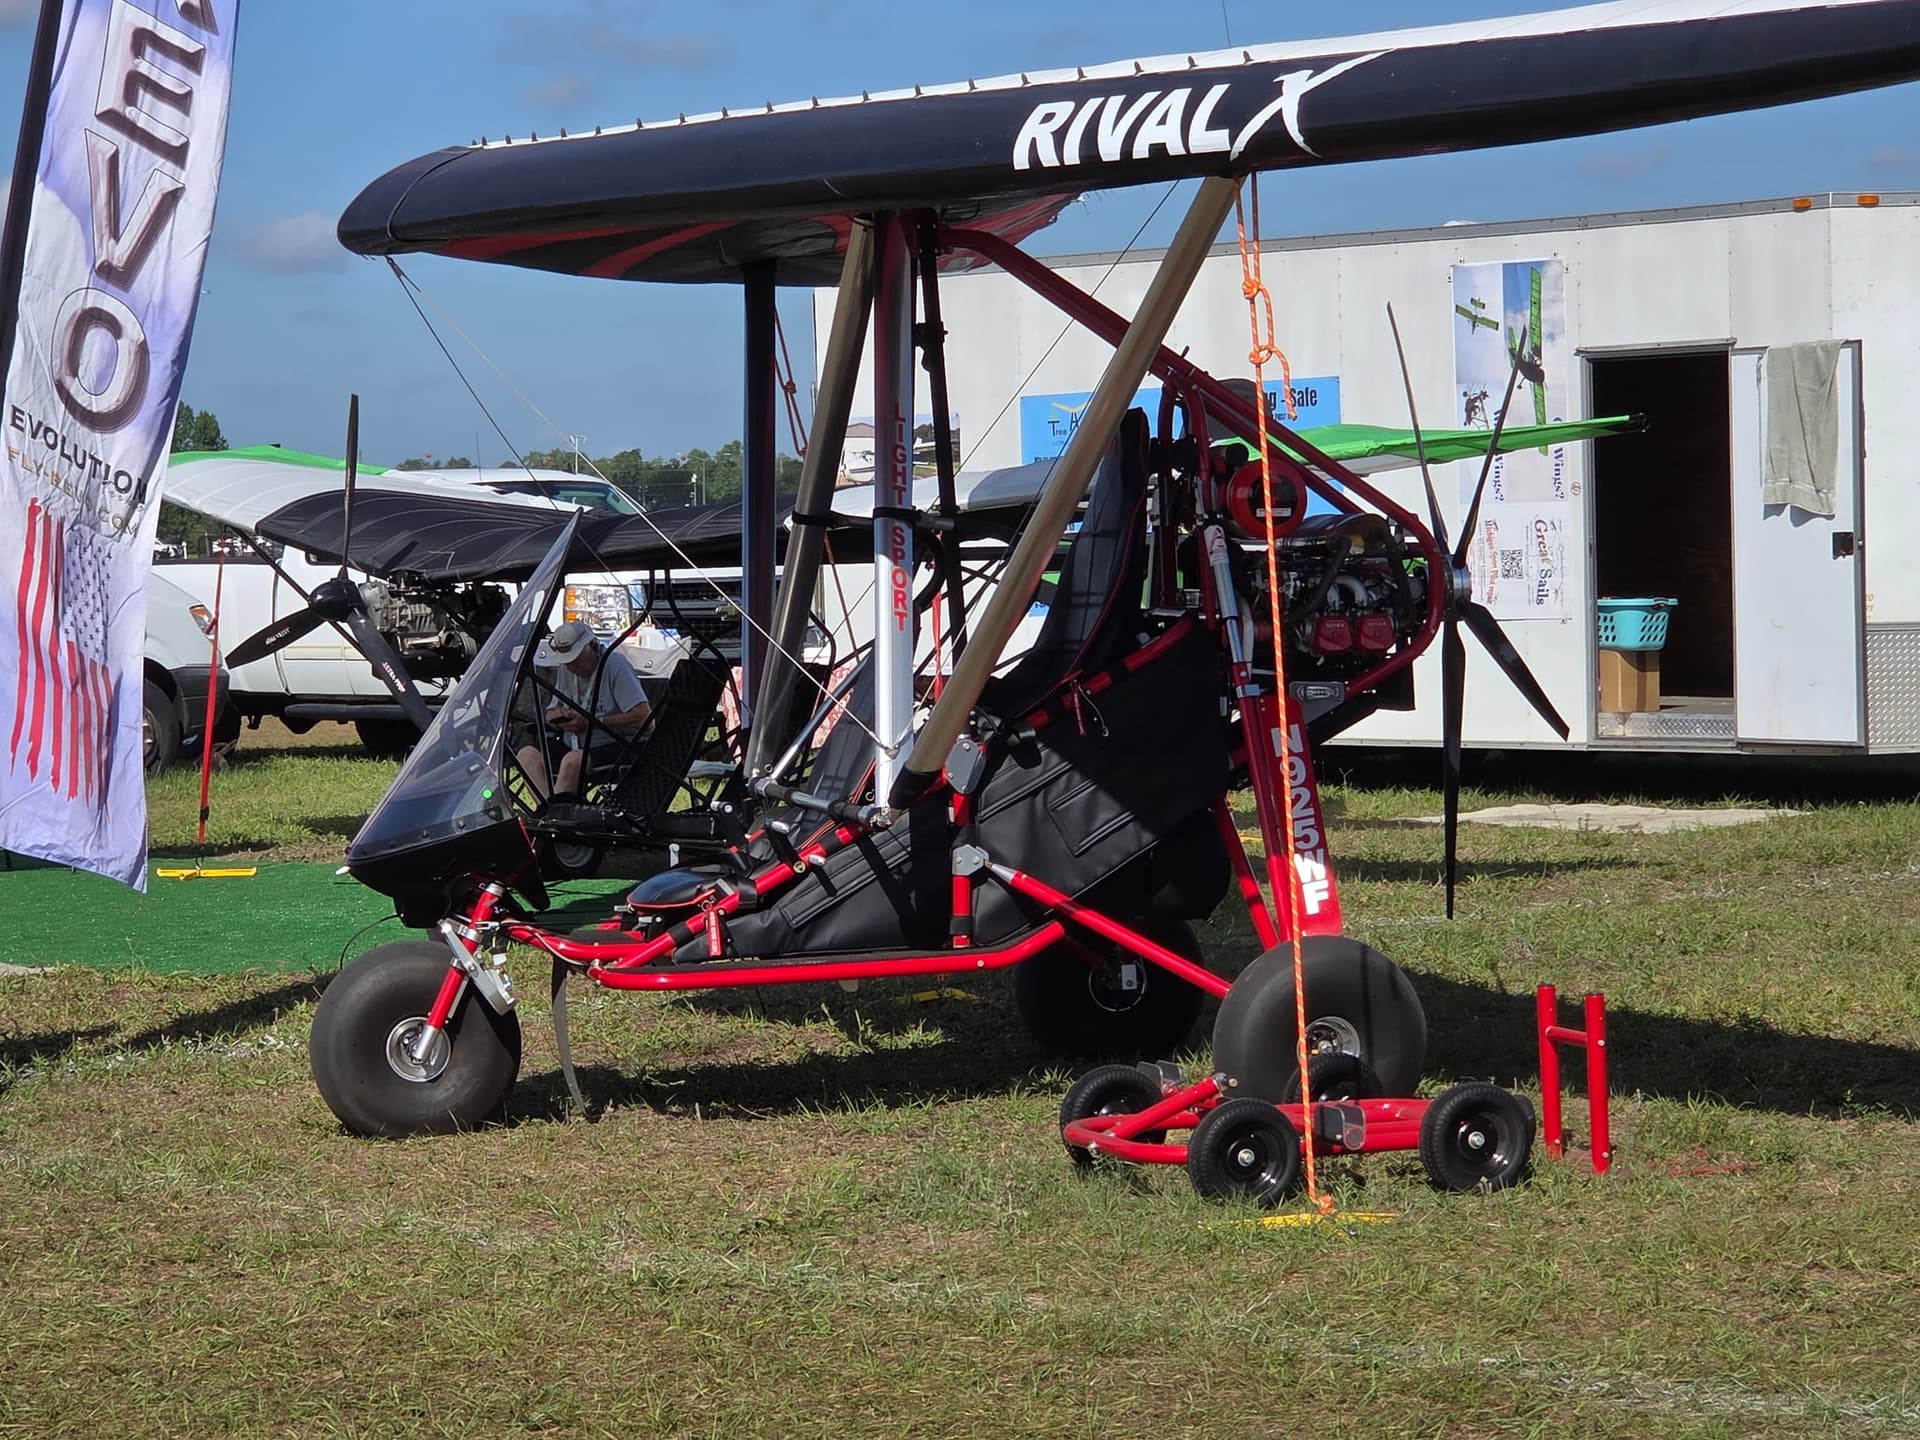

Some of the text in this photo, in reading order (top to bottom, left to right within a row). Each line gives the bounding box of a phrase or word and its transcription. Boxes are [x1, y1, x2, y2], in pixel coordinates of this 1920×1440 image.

[1013, 48, 1394, 170] RIVAL X
[51, 0, 218, 433] EVO
[1290, 387, 1317, 407] Safe
[10, 404, 147, 504] EVOLUTION
[1552, 447, 1564, 499] Wings?
[891, 402, 908, 631] LIGHT SPORT
[1536, 568, 1552, 605] Sails
[1271, 723, 1329, 915] N925WF
